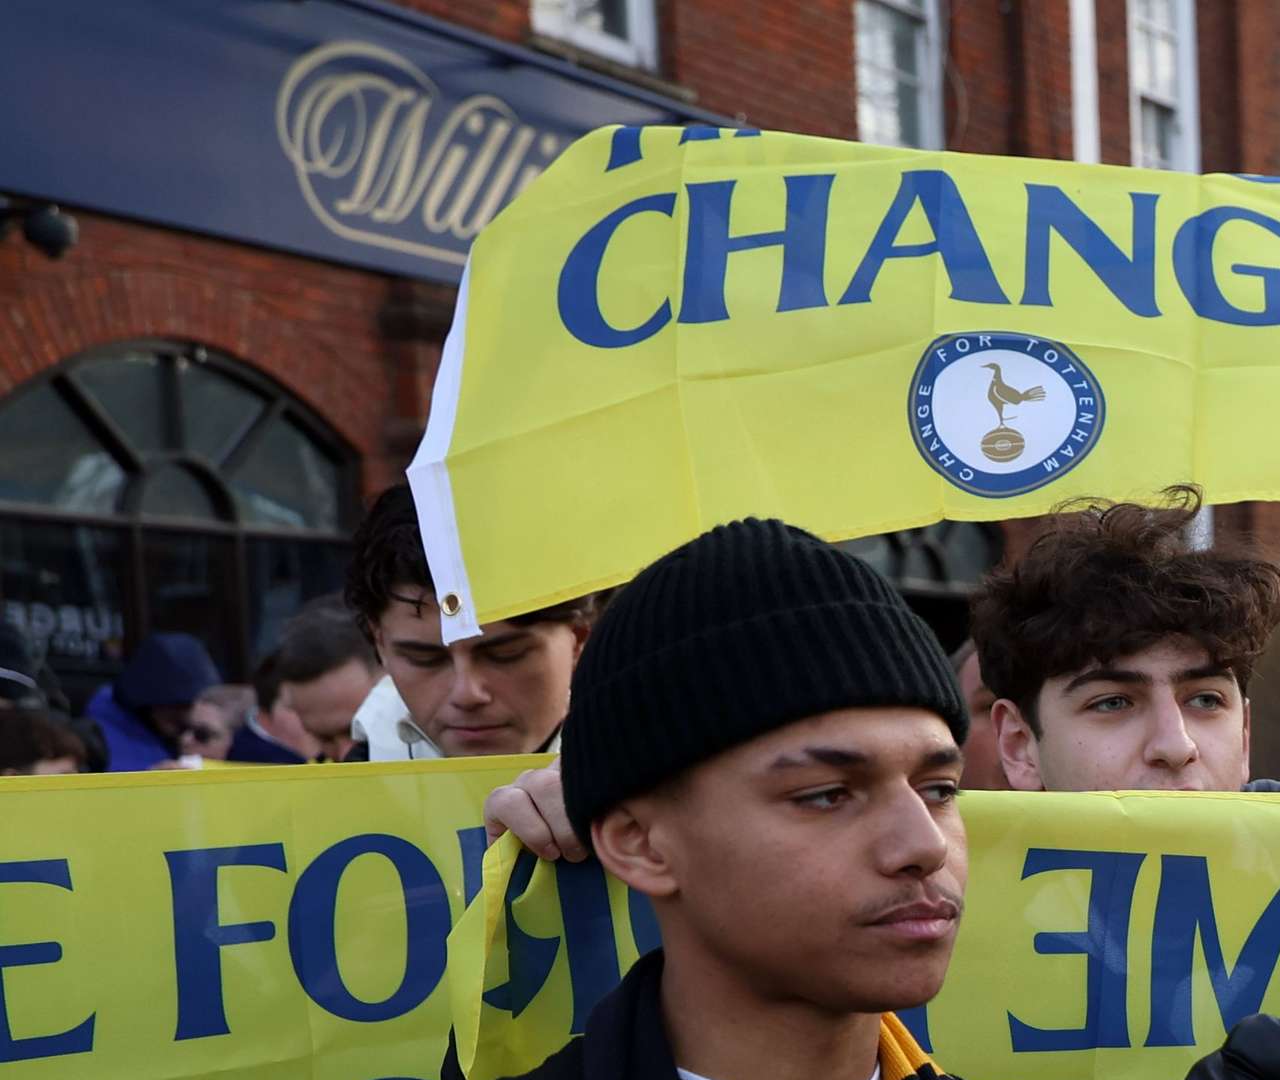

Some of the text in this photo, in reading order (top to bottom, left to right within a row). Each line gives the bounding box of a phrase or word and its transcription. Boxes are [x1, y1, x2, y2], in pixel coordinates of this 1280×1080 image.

[916, 334, 1095, 482] CHANGE FOR TOTTENHAM
[164, 827, 487, 1041] FO
